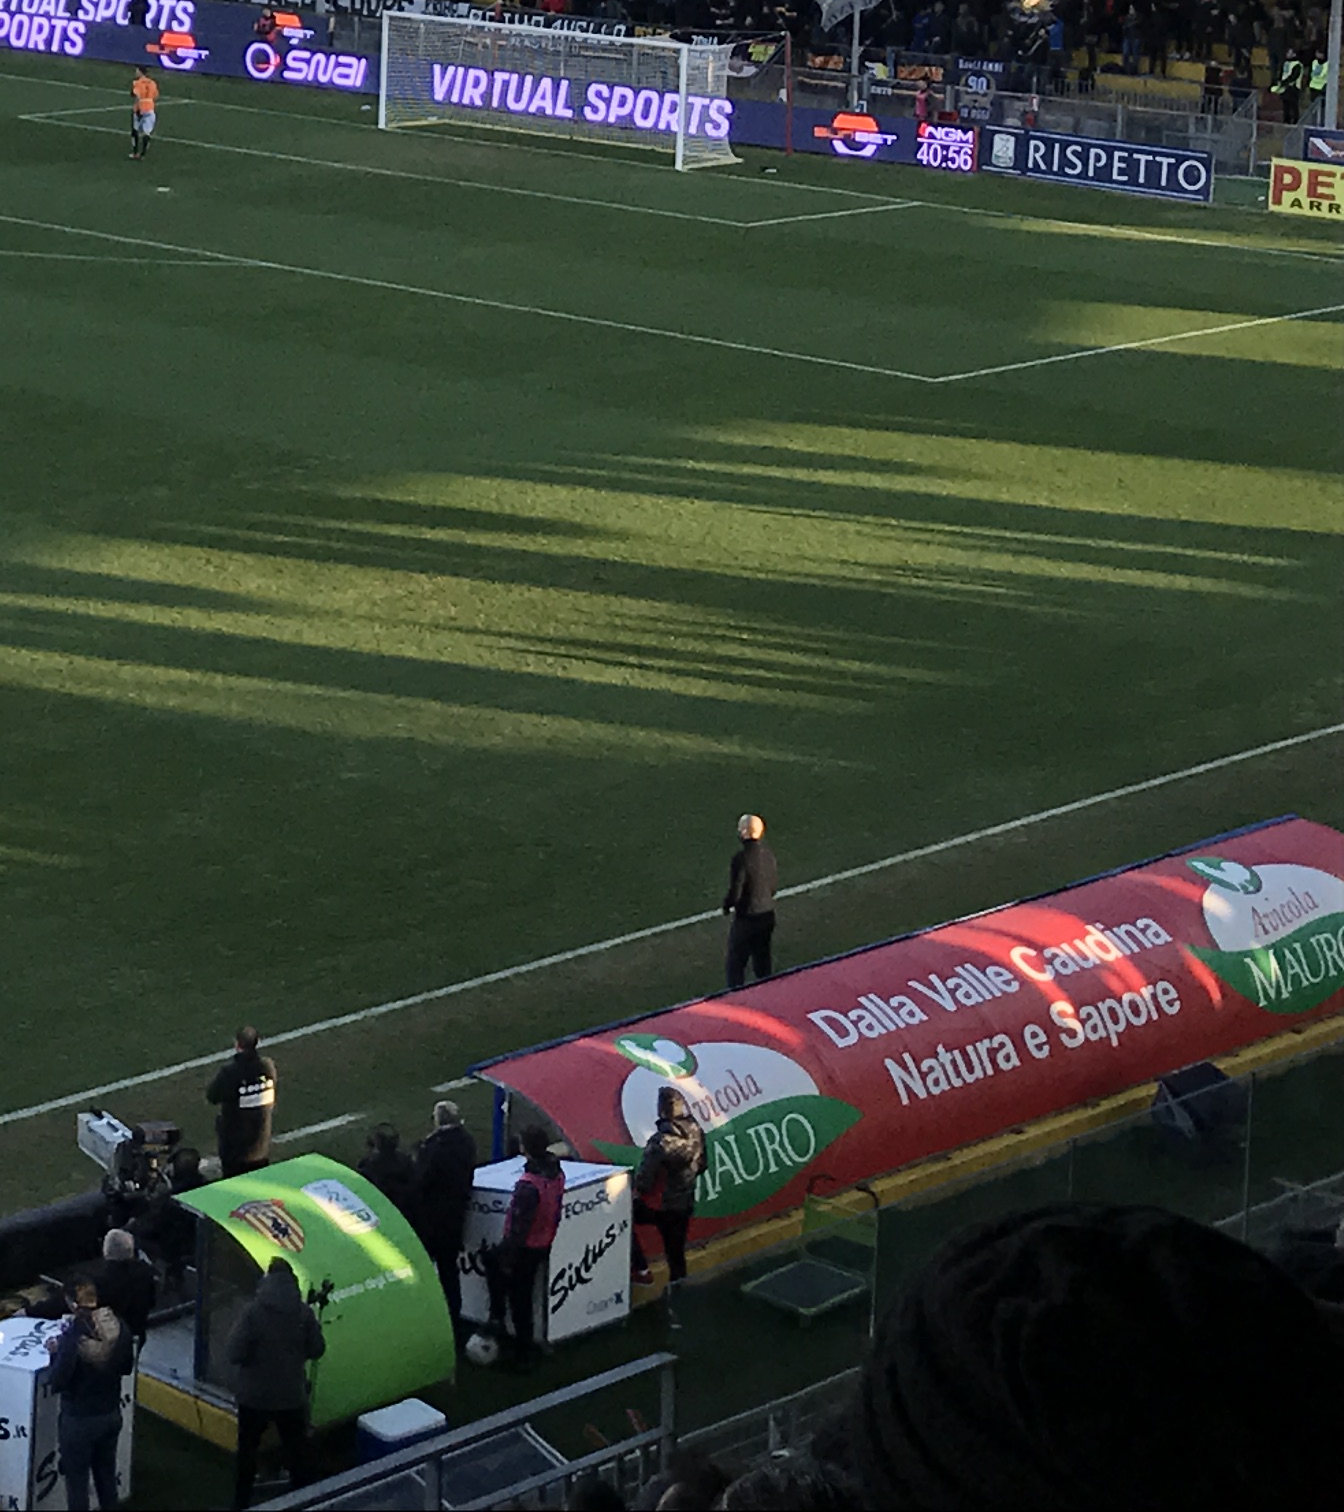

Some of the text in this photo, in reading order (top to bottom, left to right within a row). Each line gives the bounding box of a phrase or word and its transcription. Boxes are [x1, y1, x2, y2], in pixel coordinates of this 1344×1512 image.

[432, 63, 734, 139] VIRTUAL SPORTS
[916, 144, 973, 171] 40:56
[924, 127, 974, 143] NGM
[1027, 139, 1208, 192] RISPETTO
[1251, 886, 1319, 938] Avicola
[807, 915, 1173, 1049] Dalla Valle Caudina
[1243, 925, 1344, 1007] MAUR
[884, 978, 1183, 1106] Natura e Sapore
